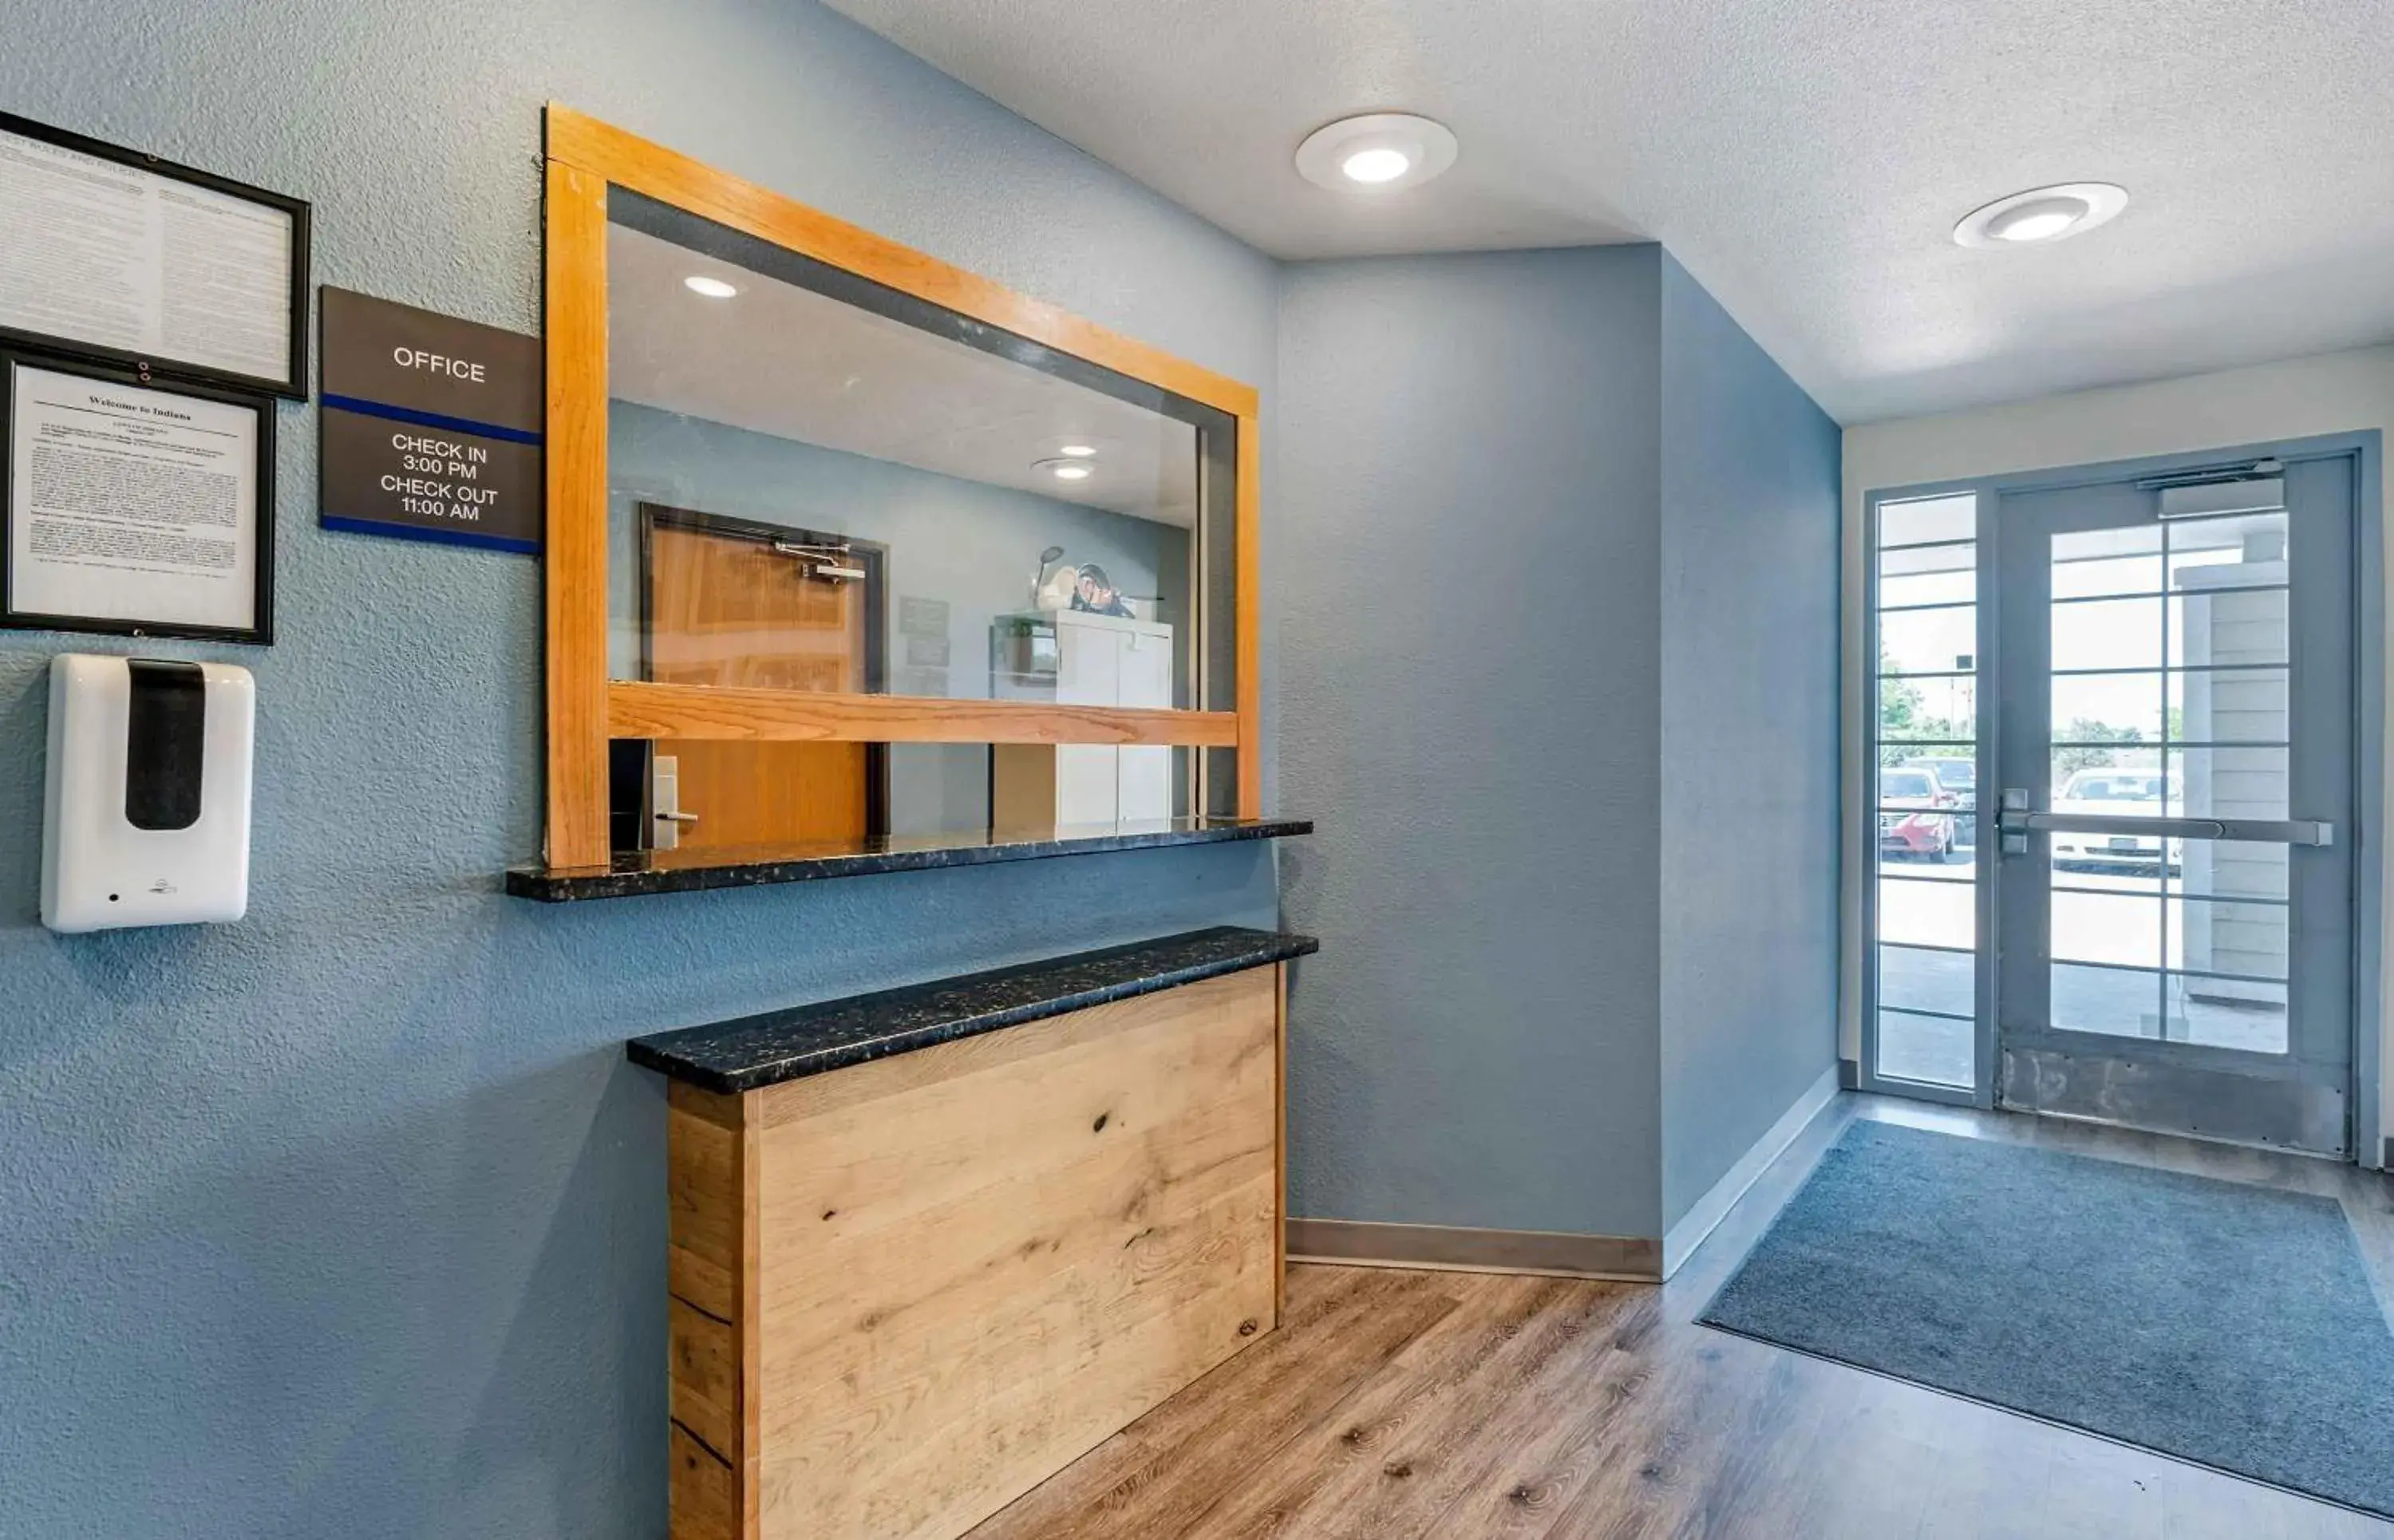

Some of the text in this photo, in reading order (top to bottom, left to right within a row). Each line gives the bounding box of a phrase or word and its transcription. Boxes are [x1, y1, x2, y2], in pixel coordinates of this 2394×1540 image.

[393, 346, 485, 384] OFFICE
[89, 396, 137, 411] Welcome
[153, 408, 192, 421] Indiana
[392, 433, 488, 464] CHECK IN
[403, 454, 476, 480] 3:00 PM
[381, 475, 498, 505] CHECK OUT
[401, 497, 480, 521] 11:00 AM
